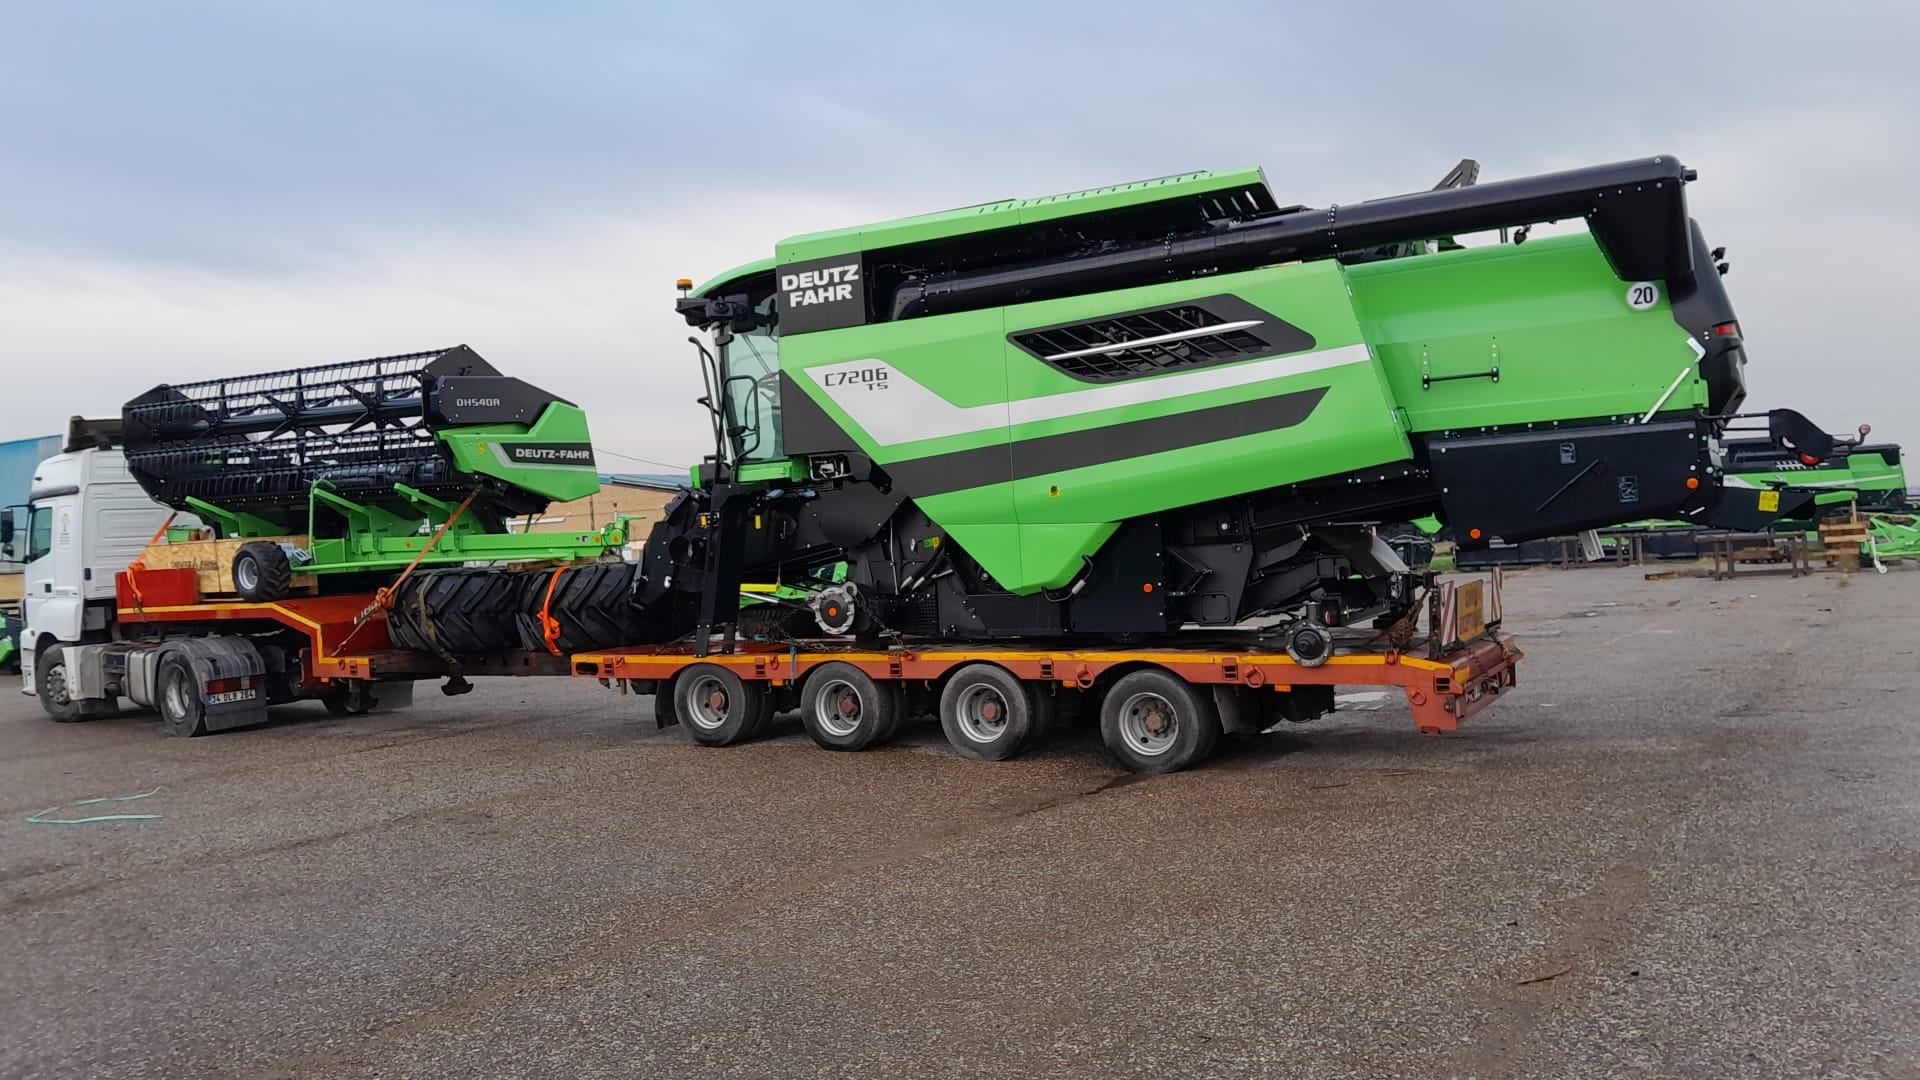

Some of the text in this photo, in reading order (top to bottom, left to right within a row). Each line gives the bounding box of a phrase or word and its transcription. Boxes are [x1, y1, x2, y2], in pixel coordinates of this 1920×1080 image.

[781, 264, 859, 291] DEUTZ
[790, 283, 853, 307] FAHR
[1633, 286, 1654, 305] 20
[825, 367, 888, 386] C7206
[865, 381, 888, 391] TS
[456, 398, 500, 407] DH540R
[515, 448, 590, 459] DEUTZ-FAHR
